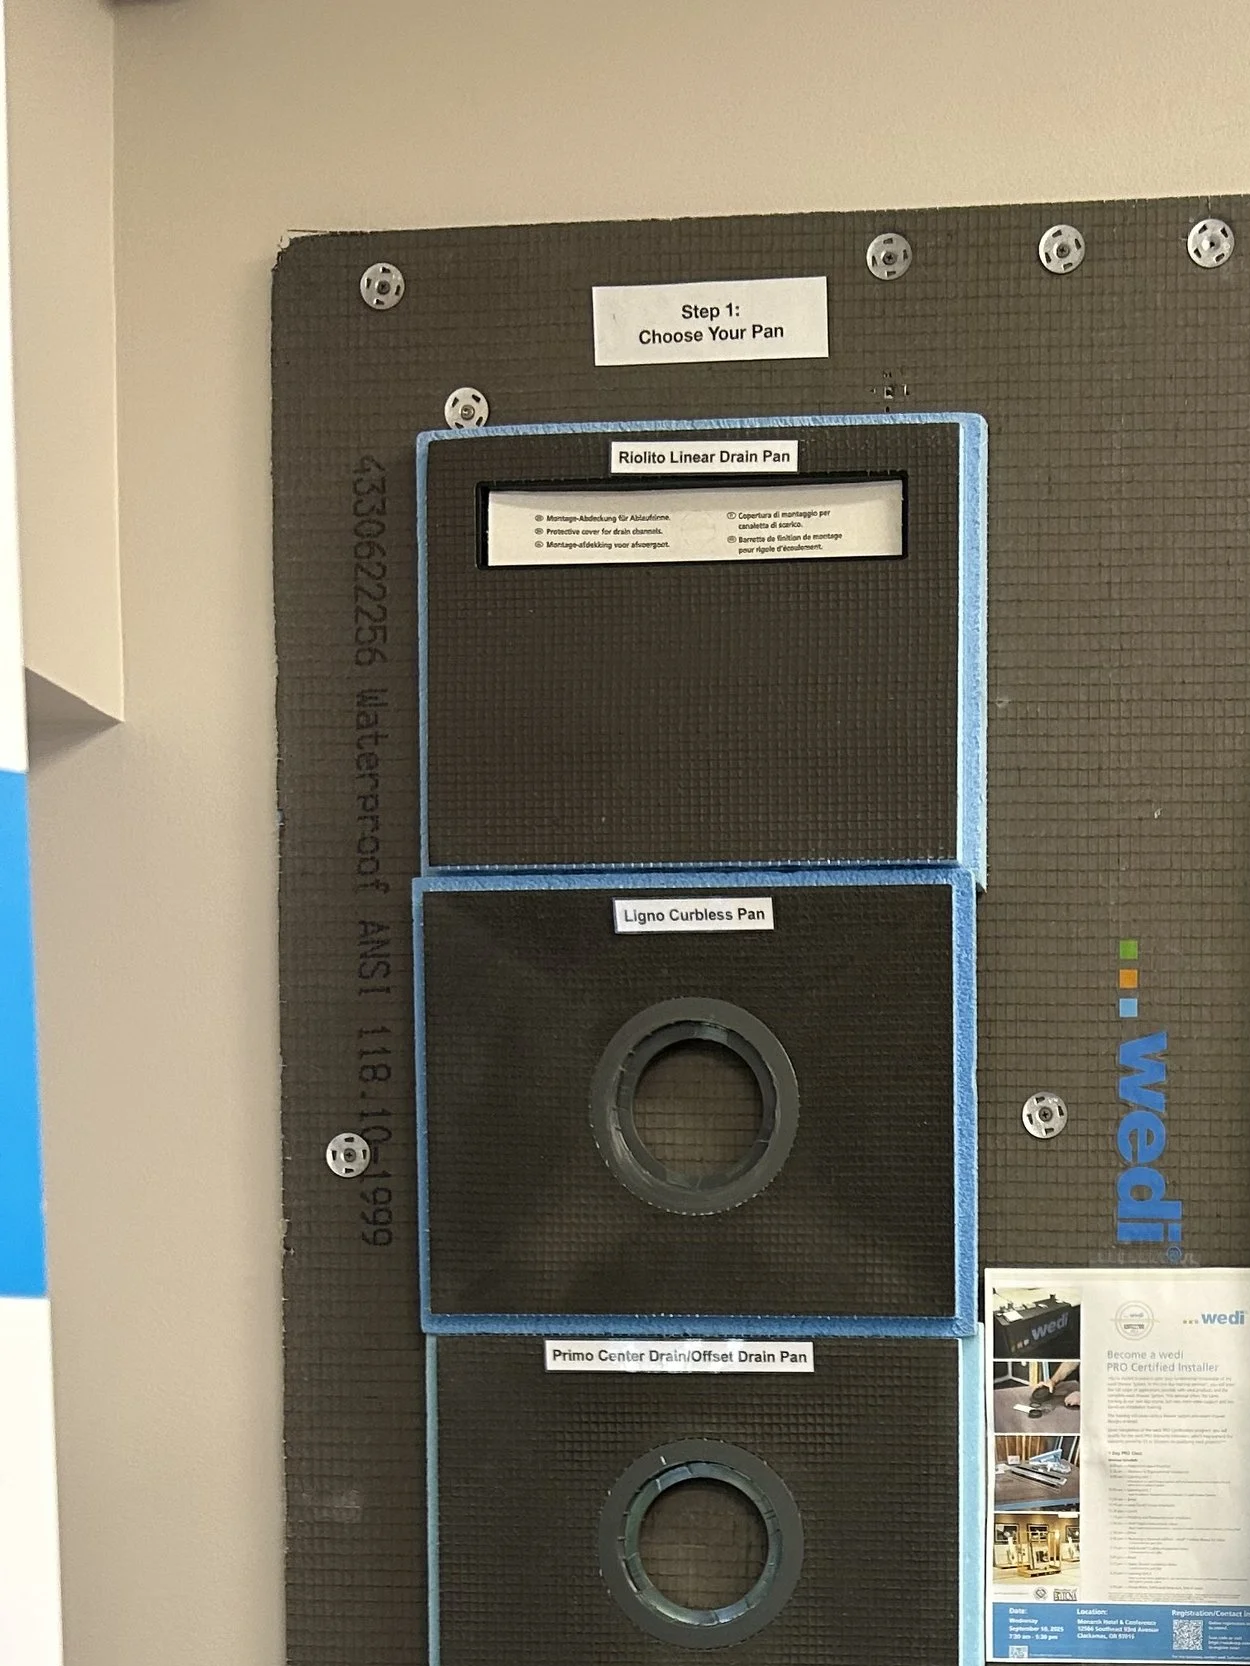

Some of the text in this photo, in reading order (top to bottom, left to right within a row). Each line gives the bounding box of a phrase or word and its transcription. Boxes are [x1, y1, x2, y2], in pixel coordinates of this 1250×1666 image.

[682, 303, 739, 321] Step 1:
[639, 324, 784, 345] Choose Your Pan
[620, 450, 790, 464] Riolito Linear Drain Pan
[625, 908, 765, 925] Ligno Curbless Pan
[358, 920, 391, 995] ANSI
[1030, 1314, 1069, 1341] wedi
[553, 1350, 807, 1363] Primo Center Drain/Offset Drain Pan
[1108, 1350, 1147, 1359] Become
[1159, 1350, 1183, 1360] wedi
[1107, 1362, 1218, 1372] PRO Certified Installer
[1077, 1608, 1108, 1616] Location:
